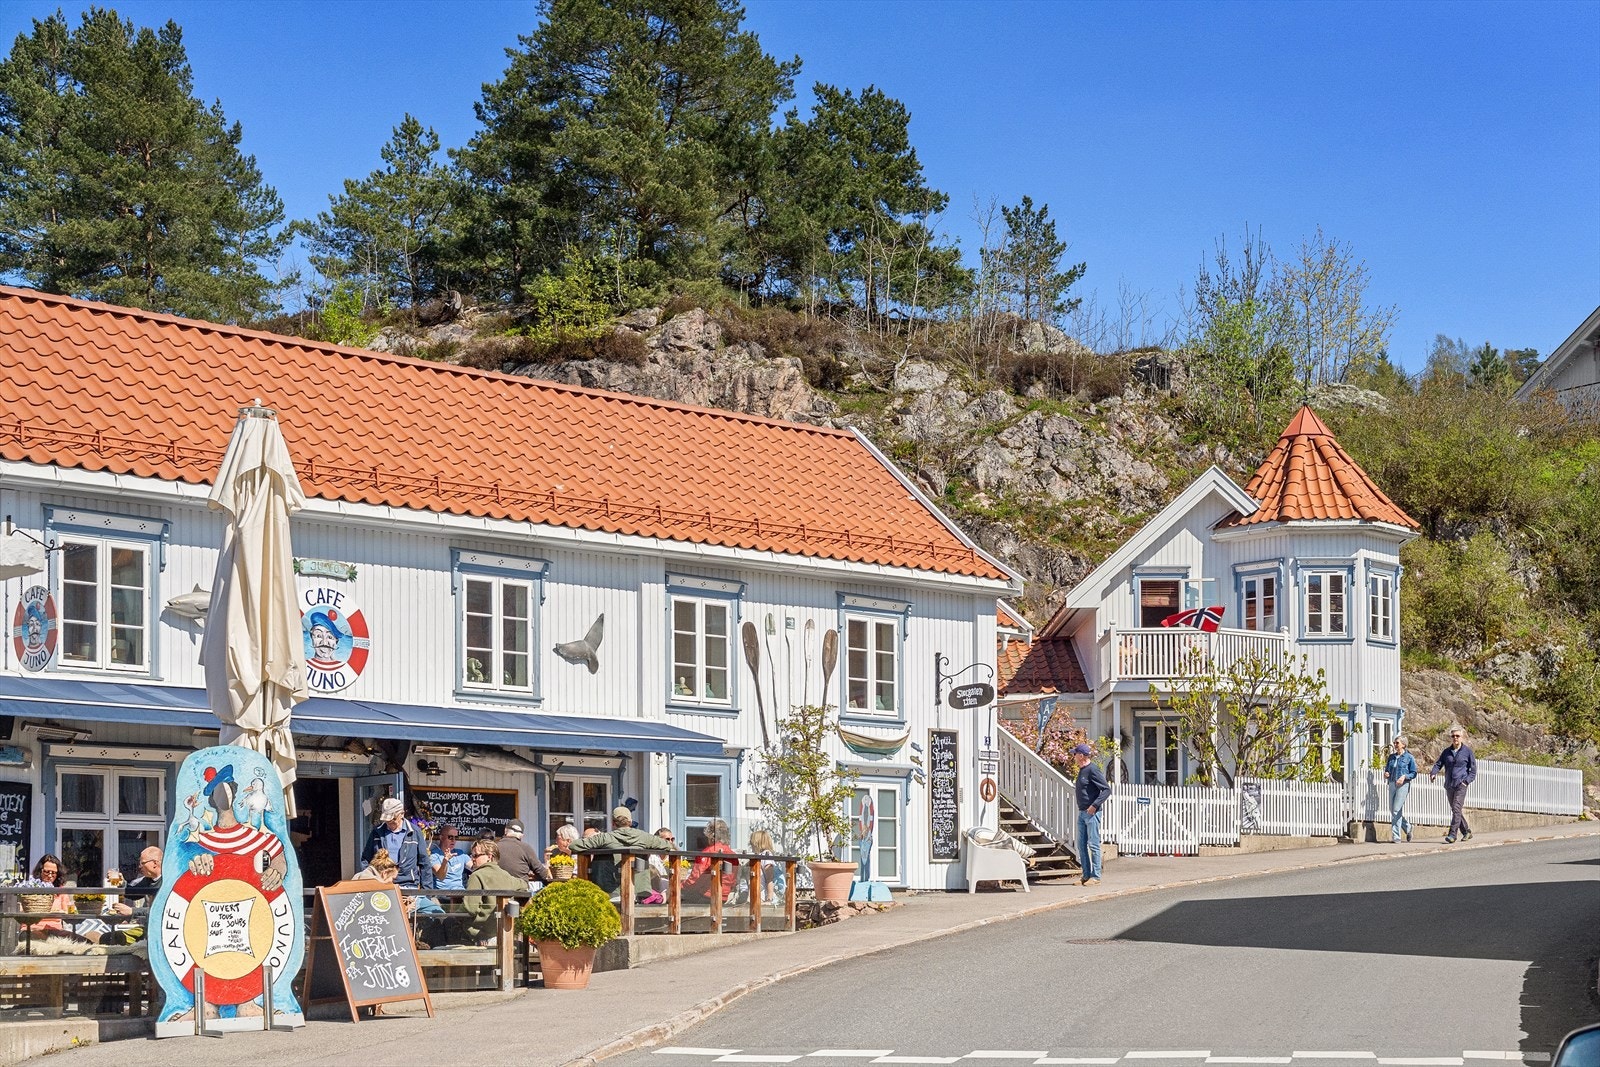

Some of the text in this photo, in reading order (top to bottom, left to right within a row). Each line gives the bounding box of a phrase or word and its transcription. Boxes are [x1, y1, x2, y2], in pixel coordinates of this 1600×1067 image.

[305, 587, 345, 609] CAFE
[23, 649, 47, 668] JUNO
[306, 665, 346, 690] JUNO
[426, 791, 485, 801] VELKOMMEN TIL
[209, 903, 240, 913] OUVERT
[226, 917, 247, 928] JOURS
[361, 924, 383, 935] MED
[209, 928, 223, 937] SAUF
[270, 904, 290, 968] JUNO
[339, 933, 406, 961] FOTBALL
